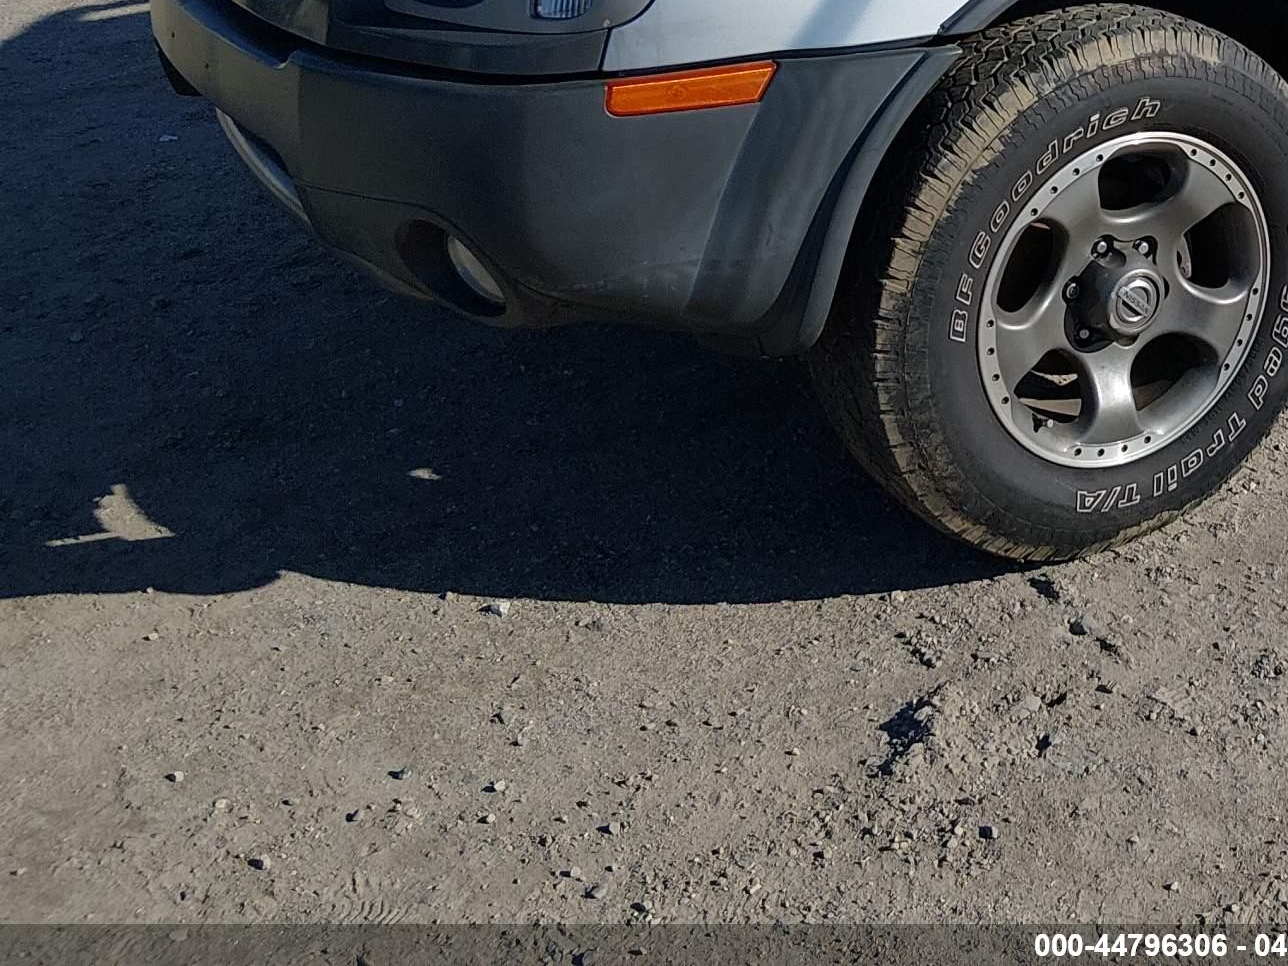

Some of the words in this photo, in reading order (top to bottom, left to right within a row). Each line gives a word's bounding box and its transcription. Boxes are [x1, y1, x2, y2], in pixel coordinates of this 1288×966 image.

[949, 96, 1161, 343] BFGoodrich
[1152, 411, 1247, 497] Trail
[1076, 482, 1141, 513] T/A
